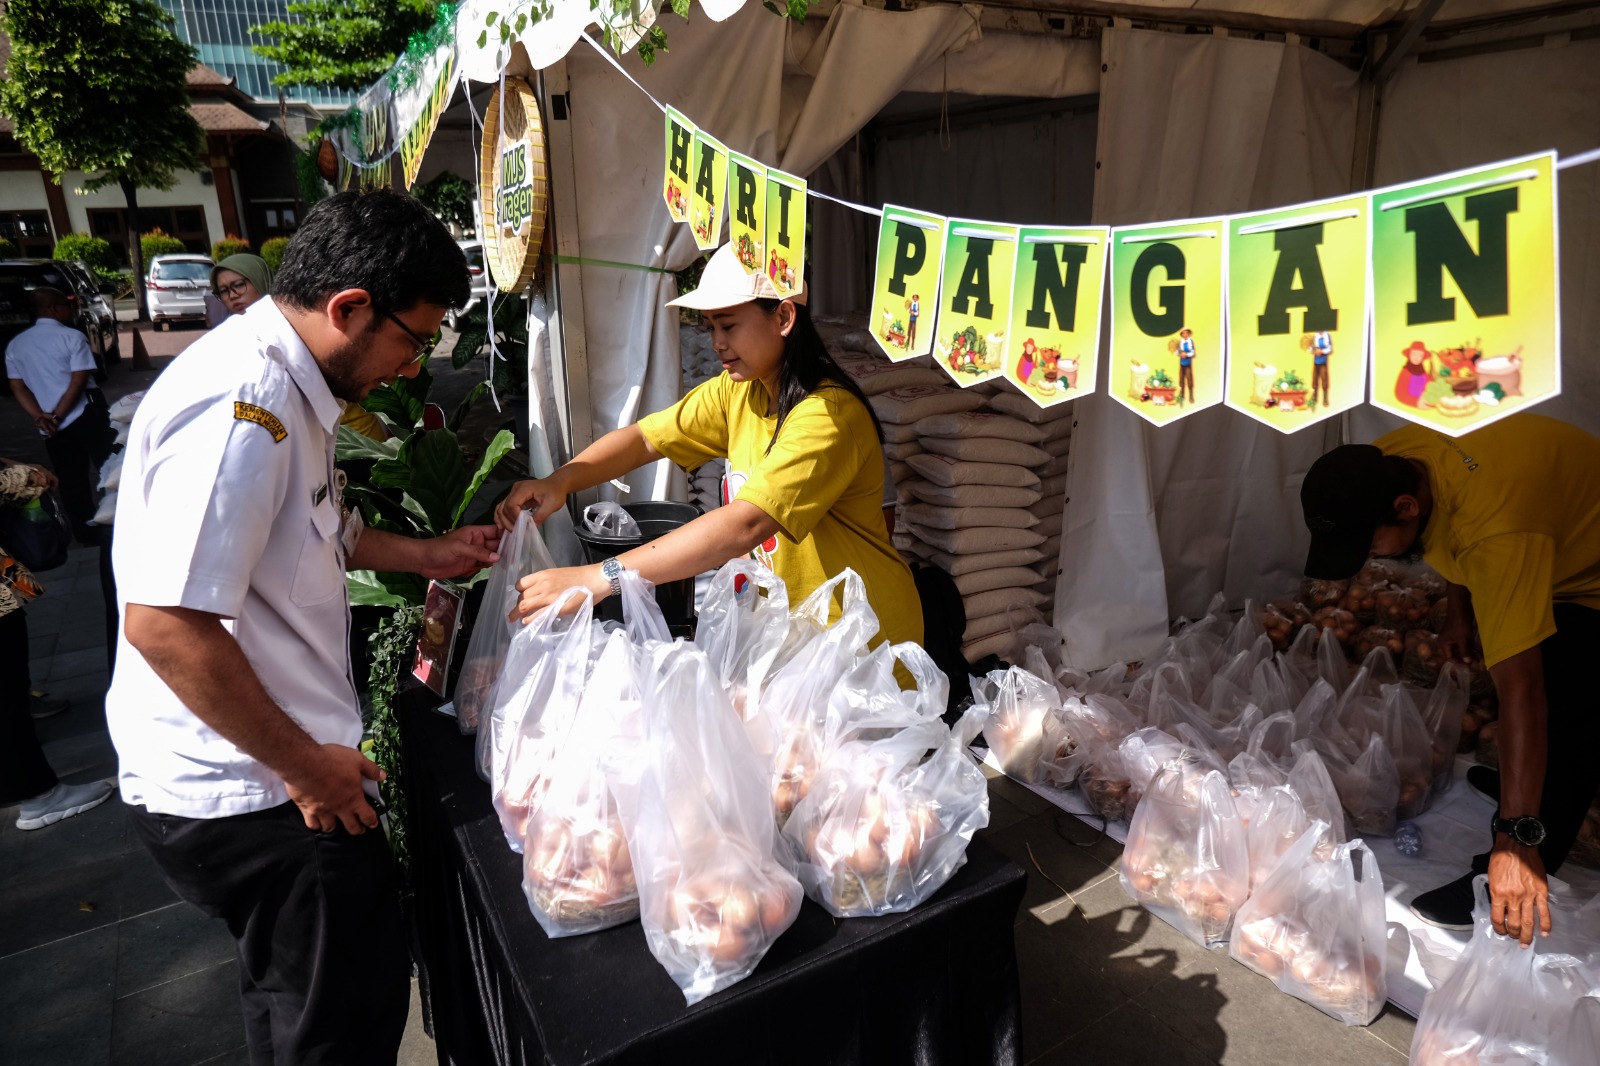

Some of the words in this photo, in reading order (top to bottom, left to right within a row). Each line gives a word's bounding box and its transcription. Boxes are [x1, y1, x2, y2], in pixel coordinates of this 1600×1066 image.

[503, 144, 526, 189] MJS
[670, 122, 792, 249] HARI
[887, 187, 1519, 339] PANGAN
[239, 411, 262, 422] DALAM
[239, 404, 284, 435] KEMENTERIAN
